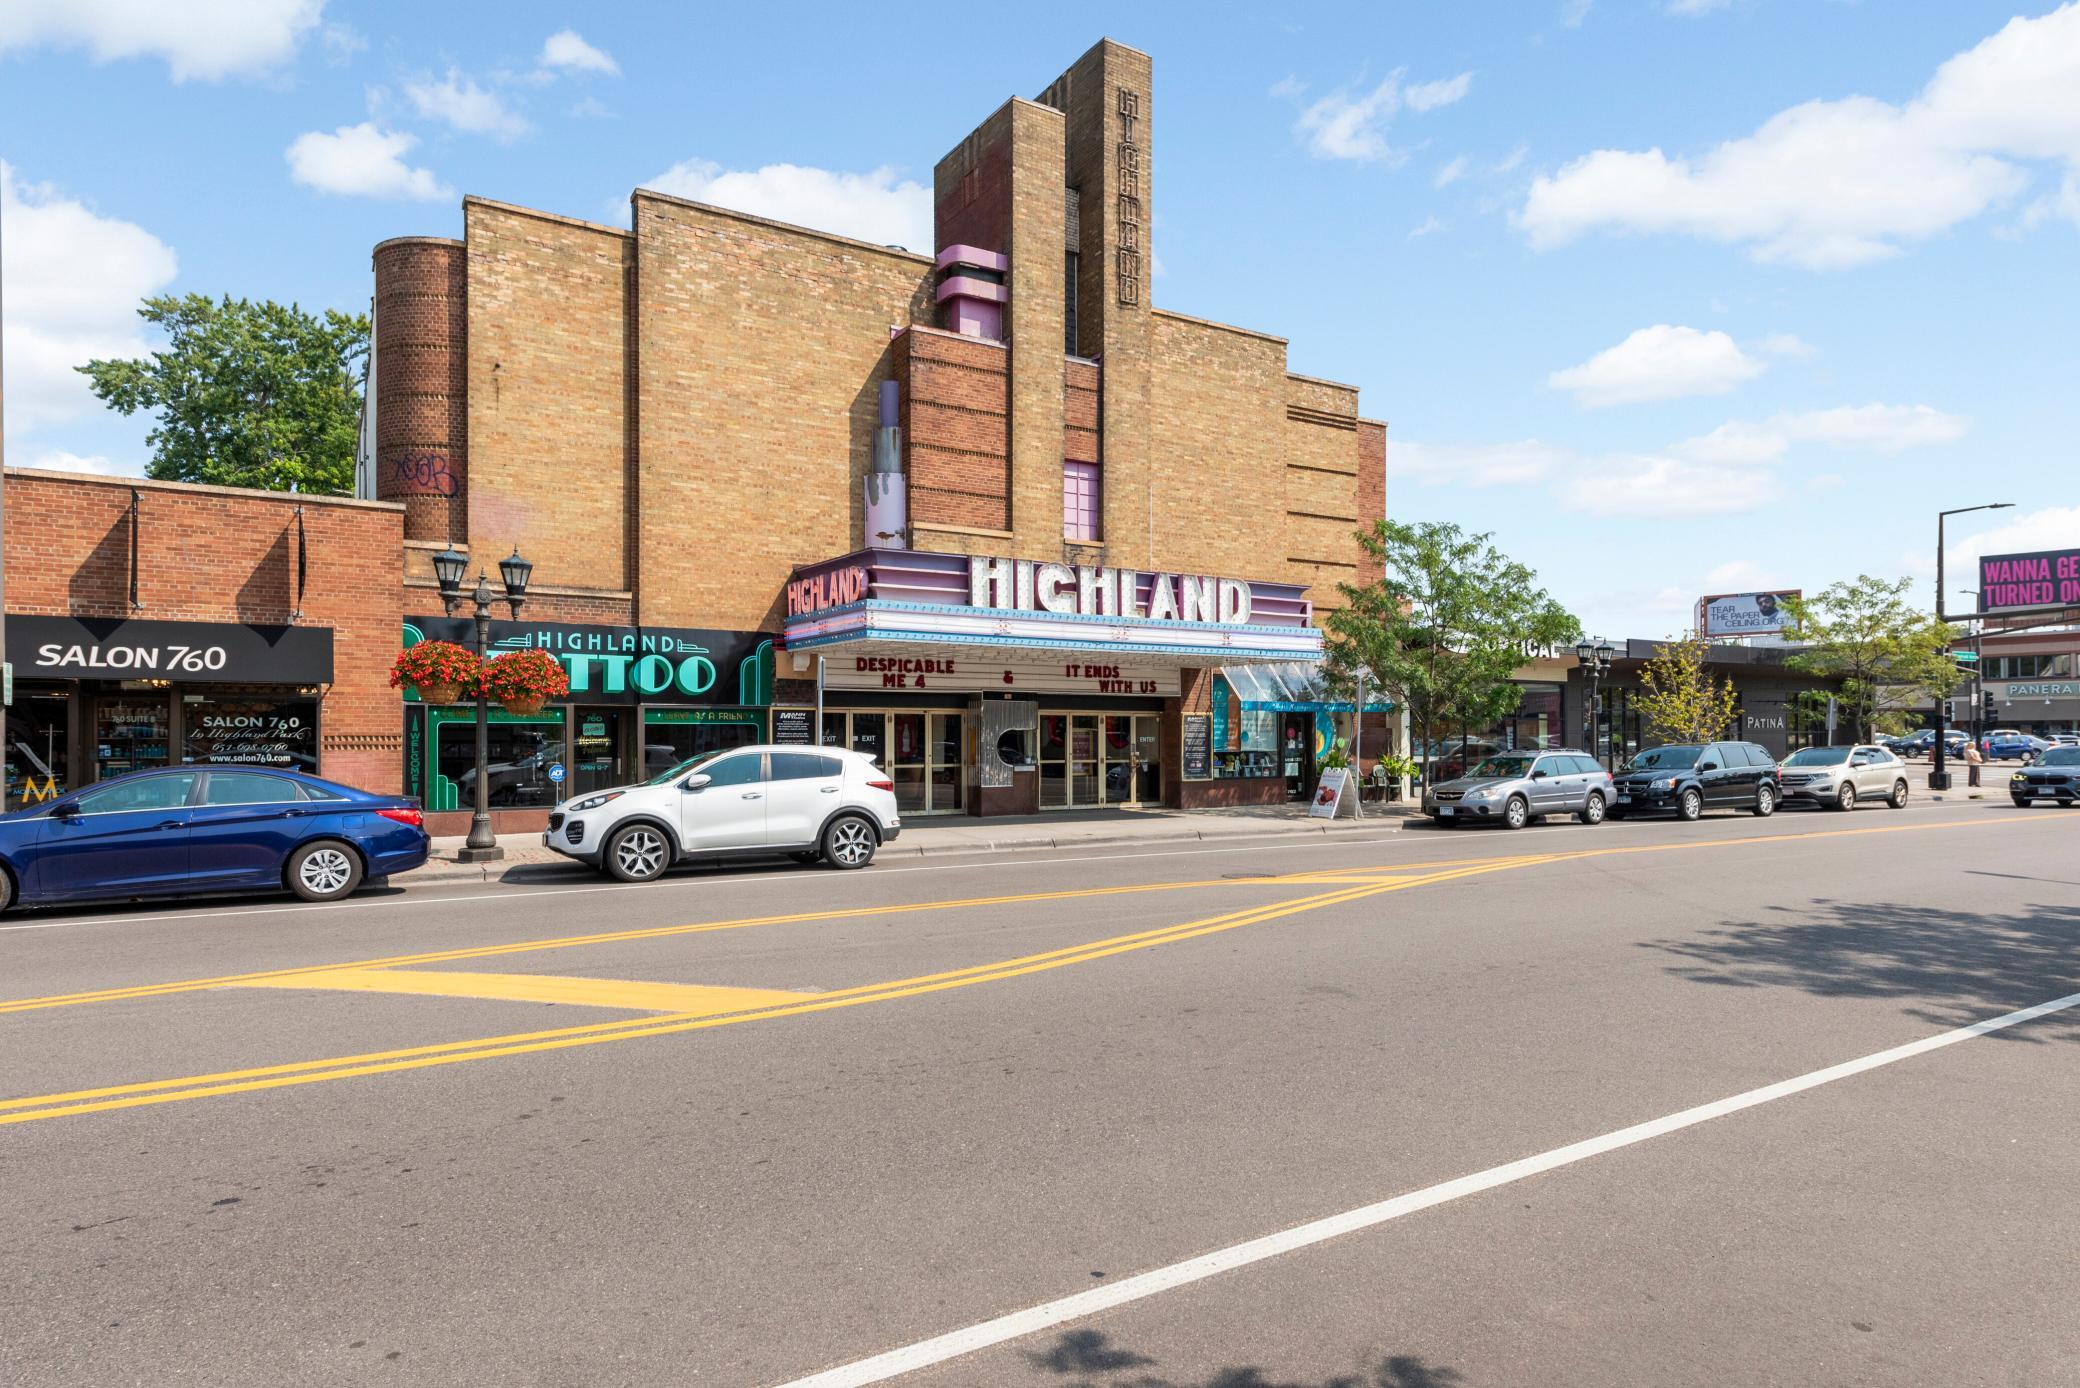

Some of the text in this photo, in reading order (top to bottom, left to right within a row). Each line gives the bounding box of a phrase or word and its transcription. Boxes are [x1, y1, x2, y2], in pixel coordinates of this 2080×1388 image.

[1119, 87, 1141, 306] HIGHLAND
[1983, 558, 2051, 583] WANNA
[787, 565, 864, 616] HIGHLAND
[971, 555, 1251, 624] HIGHLAND
[1983, 582, 2054, 607] TURNED
[1711, 605, 1735, 613] TEAR
[1711, 611, 1760, 621] THE PAPER
[1724, 617, 1784, 628] CEILING.ORG
[538, 631, 674, 654] HIGHLAND
[35, 644, 227, 672] SALON 760
[487, 650, 716, 695] TTOO
[856, 657, 955, 674] DESPICABLE
[1065, 664, 1120, 678] IT ENDS
[882, 674, 926, 688] ME 4
[1003, 670, 1014, 684] &
[1099, 680, 1157, 693] WITH US
[2009, 684, 2073, 695] PANERA
[112, 715, 125, 724] 760
[126, 715, 149, 723] SUITE
[203, 716, 300, 730] SALON 760
[1747, 715, 1785, 729] PATINA
[207, 728, 272, 740] Highland
[271, 727, 312, 740] Park
[209, 753, 291, 763] www.salon760.com
[410, 731, 421, 783] WELCOME
